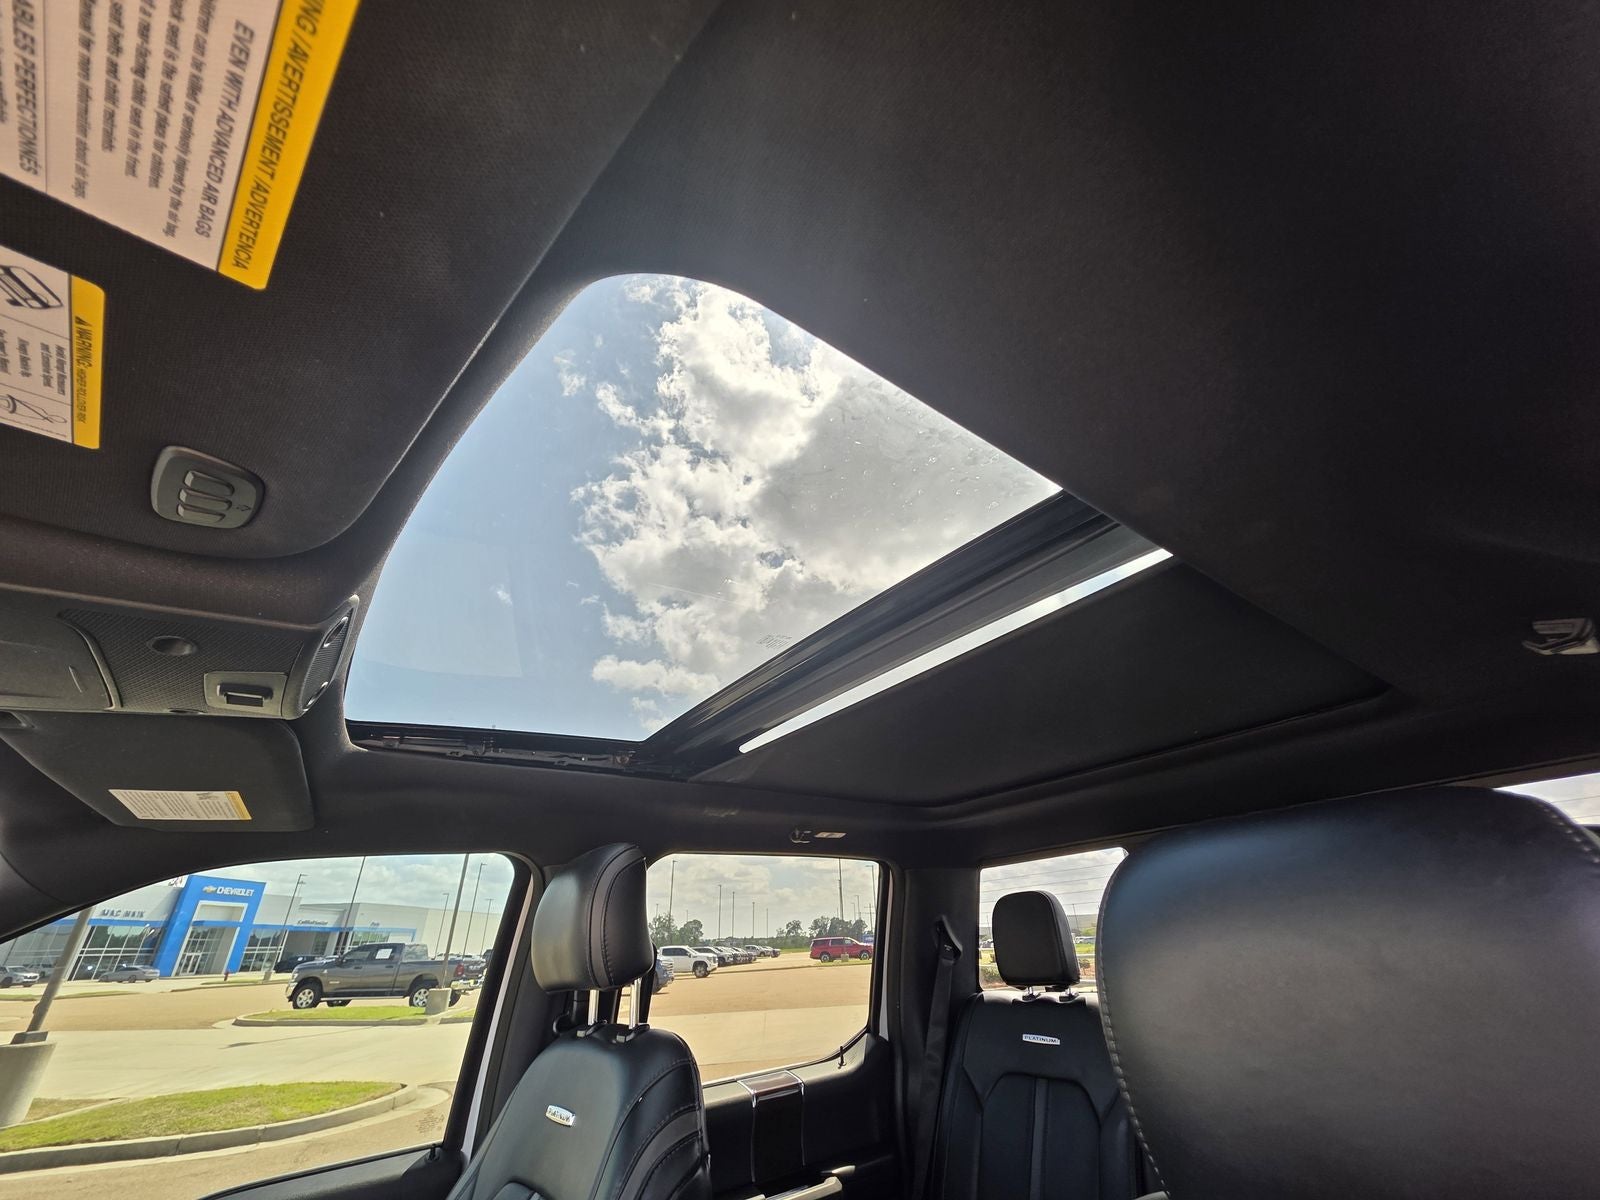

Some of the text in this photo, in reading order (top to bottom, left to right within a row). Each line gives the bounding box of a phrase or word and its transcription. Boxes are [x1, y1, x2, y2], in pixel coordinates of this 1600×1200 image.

[195, 20, 254, 239] EVEN WITH ADVANCED AIR BAGS
[216, 886, 255, 897] CHEVROLET
[1024, 1035, 1058, 1043] PLATINUM
